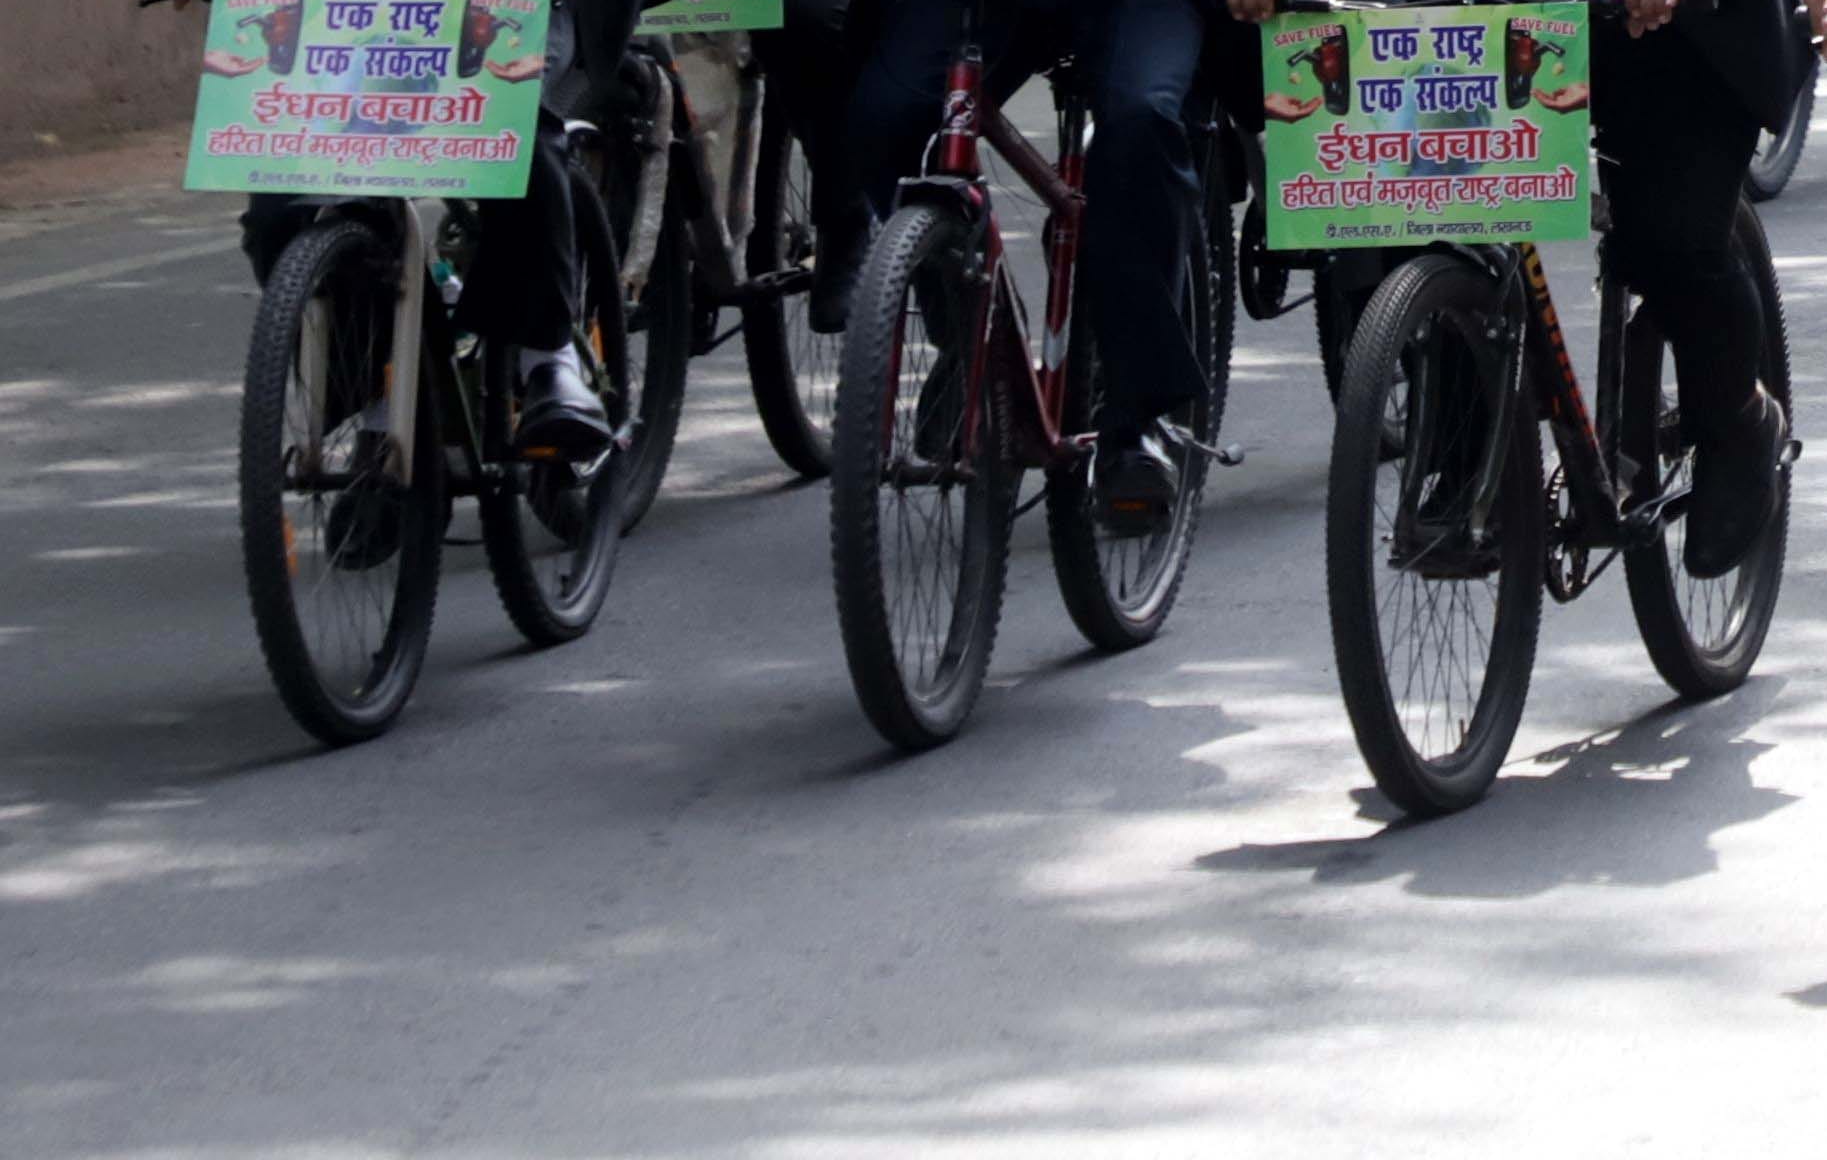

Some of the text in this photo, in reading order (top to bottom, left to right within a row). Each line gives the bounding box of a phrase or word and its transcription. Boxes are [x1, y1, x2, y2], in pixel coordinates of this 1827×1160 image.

[327, 1, 444, 37] एक राष्ट्र
[1274, 26, 1339, 45] SAVE FUEL
[1512, 18, 1576, 35] SAVE FUEL
[306, 37, 451, 78] एक संकल्प
[1369, 26, 1486, 65] एक राष्ट्र
[361, 87, 485, 123] बचाओ
[1357, 66, 1498, 112] एक संकल्प
[208, 125, 265, 156] हरित
[270, 127, 305, 157] एवं
[392, 135, 441, 164] राष्ट्र
[443, 133, 517, 160] बनाओ
[1419, 118, 1538, 162] बचाओ
[1282, 174, 1335, 208] हरित
[1341, 172, 1372, 205] एवं
[1456, 175, 1500, 207] राष्ट्र
[1504, 167, 1576, 200] बनाओ
